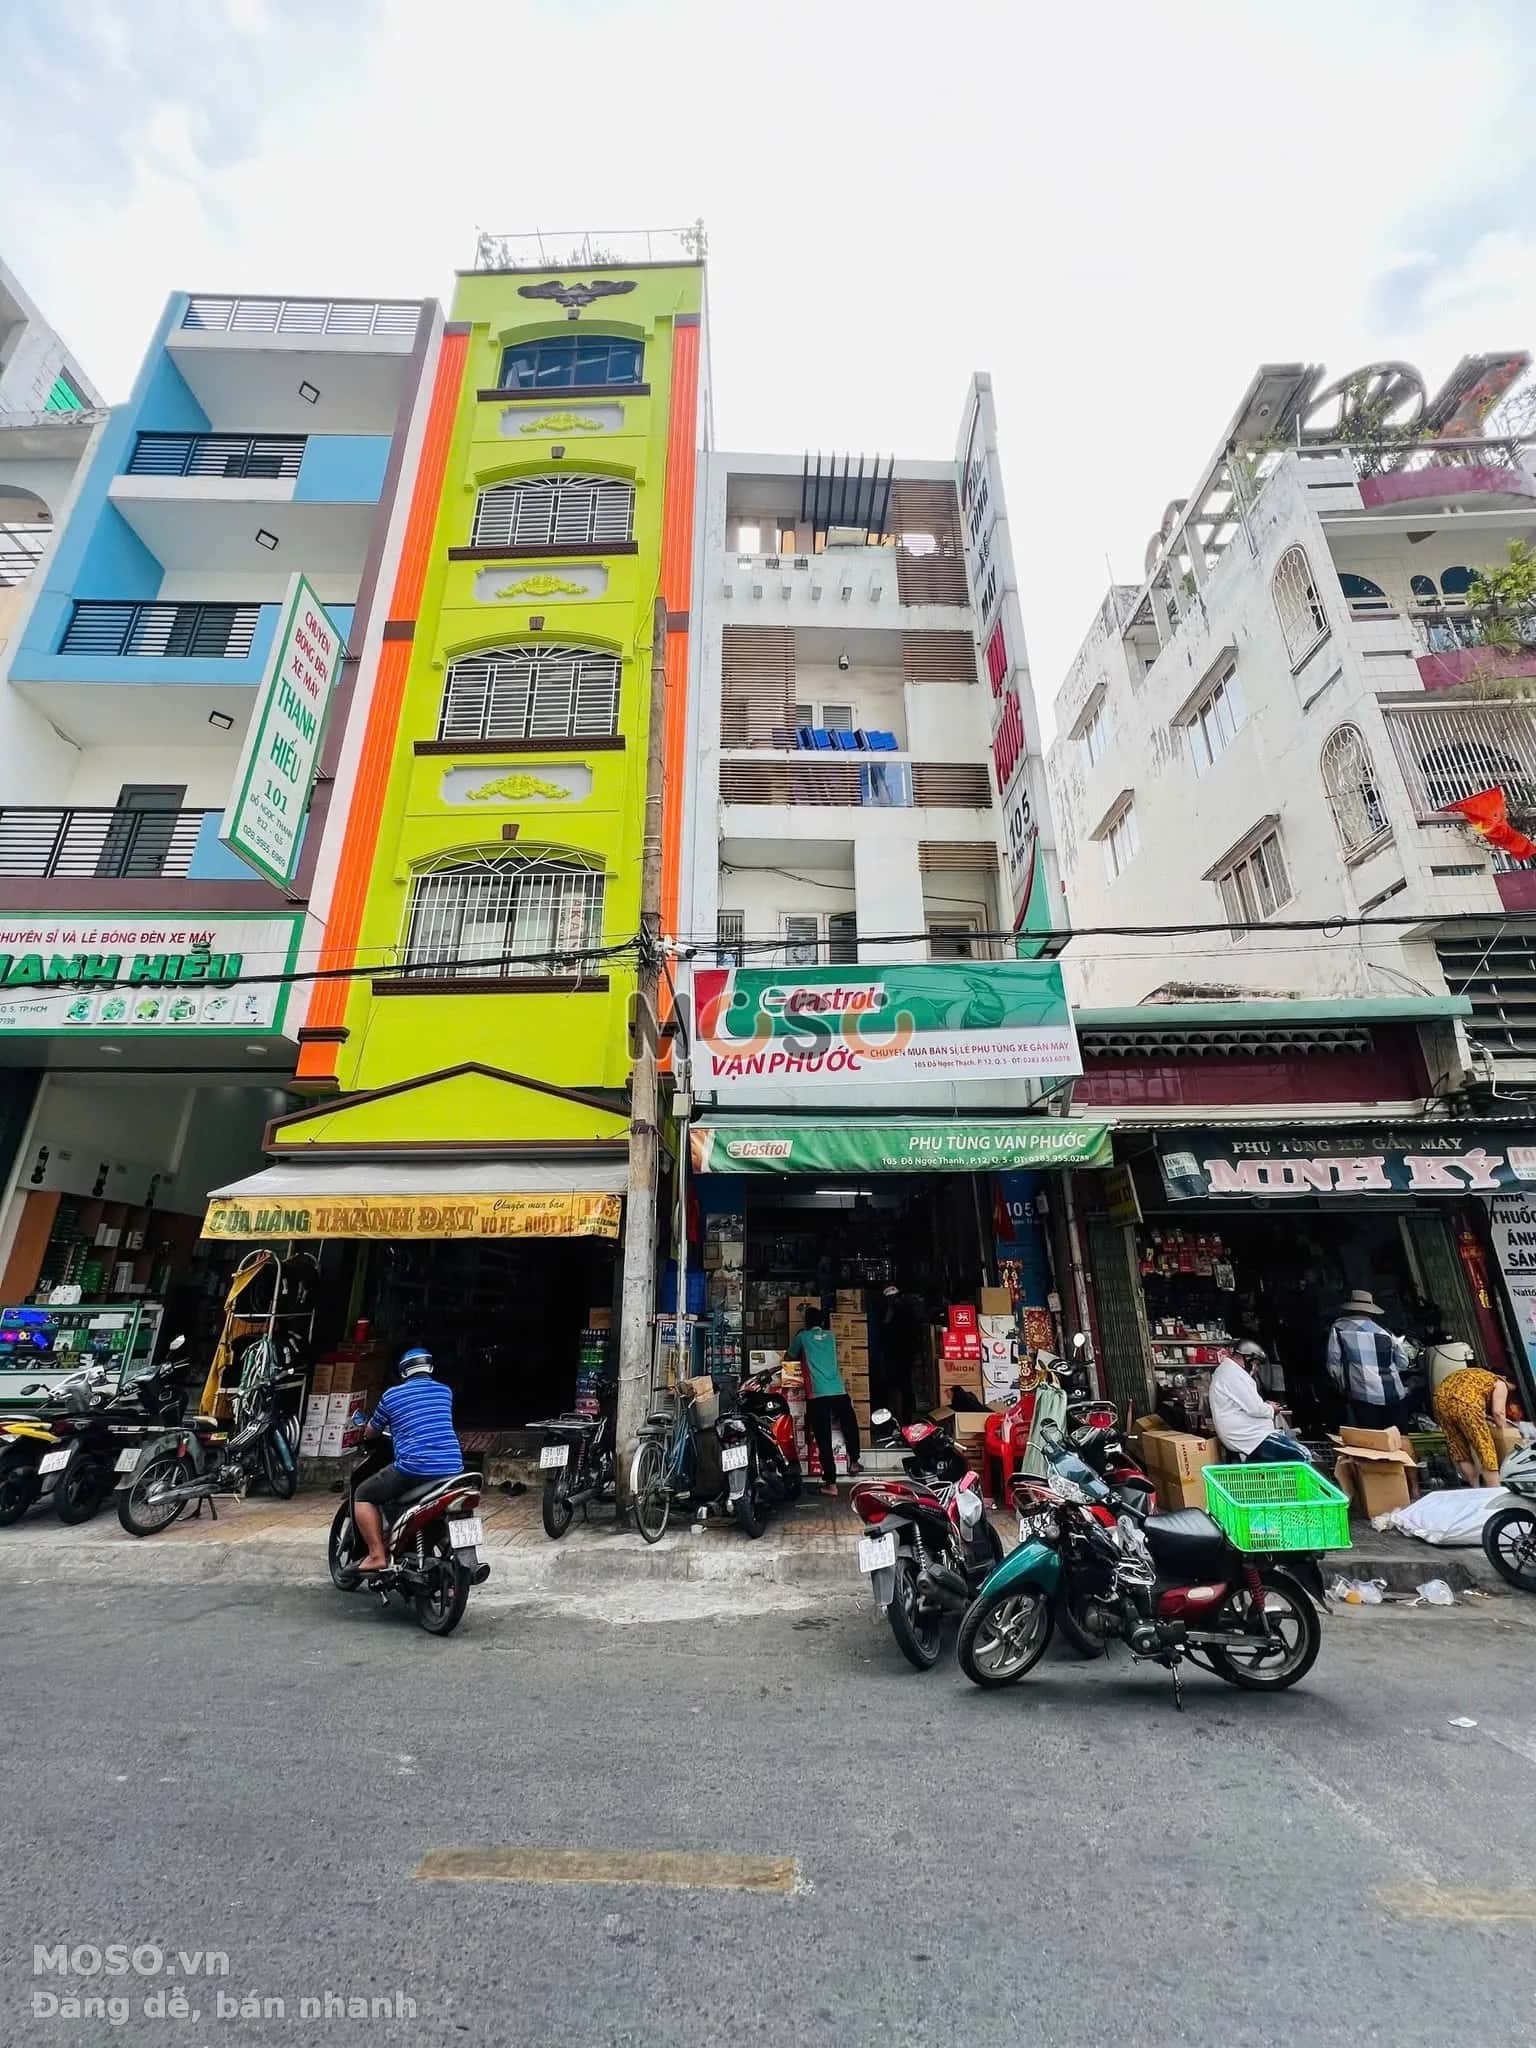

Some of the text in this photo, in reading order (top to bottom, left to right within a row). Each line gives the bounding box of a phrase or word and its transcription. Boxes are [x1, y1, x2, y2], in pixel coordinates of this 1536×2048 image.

[292, 655, 320, 700] XE MÁY
[278, 677, 317, 744] THANH
[264, 780, 287, 815] 101
[1009, 788, 1030, 848] 105
[63, 930, 77, 943] VÀ
[101, 930, 137, 944] BÓNG
[140, 930, 166, 944] ĐÈN
[169, 932, 186, 944] XE
[188, 930, 216, 944] MÁY
[0, 953, 122, 988] ANH
[789, 986, 876, 1012] Castrol
[907, 1046, 928, 1058] MUA
[992, 1041, 1016, 1053] TÙNG
[1017, 1043, 1028, 1052] XE
[1051, 1039, 1069, 1051] MÁY
[711, 1045, 865, 1081] VẠN PHƯỚC
[742, 1142, 788, 1157] Castrol
[909, 1131, 1087, 1153] PHỤ TÙNG VẠN PHƯỚC
[1231, 1140, 1272, 1156] PHỤ
[1278, 1137, 1329, 1153] TÙNG
[1337, 1139, 1363, 1151] XE
[881, 1157, 898, 1166] 105
[914, 1156, 937, 1167] Ngọc
[1203, 1156, 1393, 1193] MINH
[1403, 1147, 1505, 1190] KÝ
[208, 1203, 250, 1233] CỬA
[253, 1204, 312, 1233] HÀNG
[416, 1206, 479, 1237] ĐẠT
[1006, 1202, 1033, 1217] 105
[480, 1212, 498, 1234] VỎ
[500, 1216, 516, 1234] XE
[560, 1215, 576, 1234] XE
